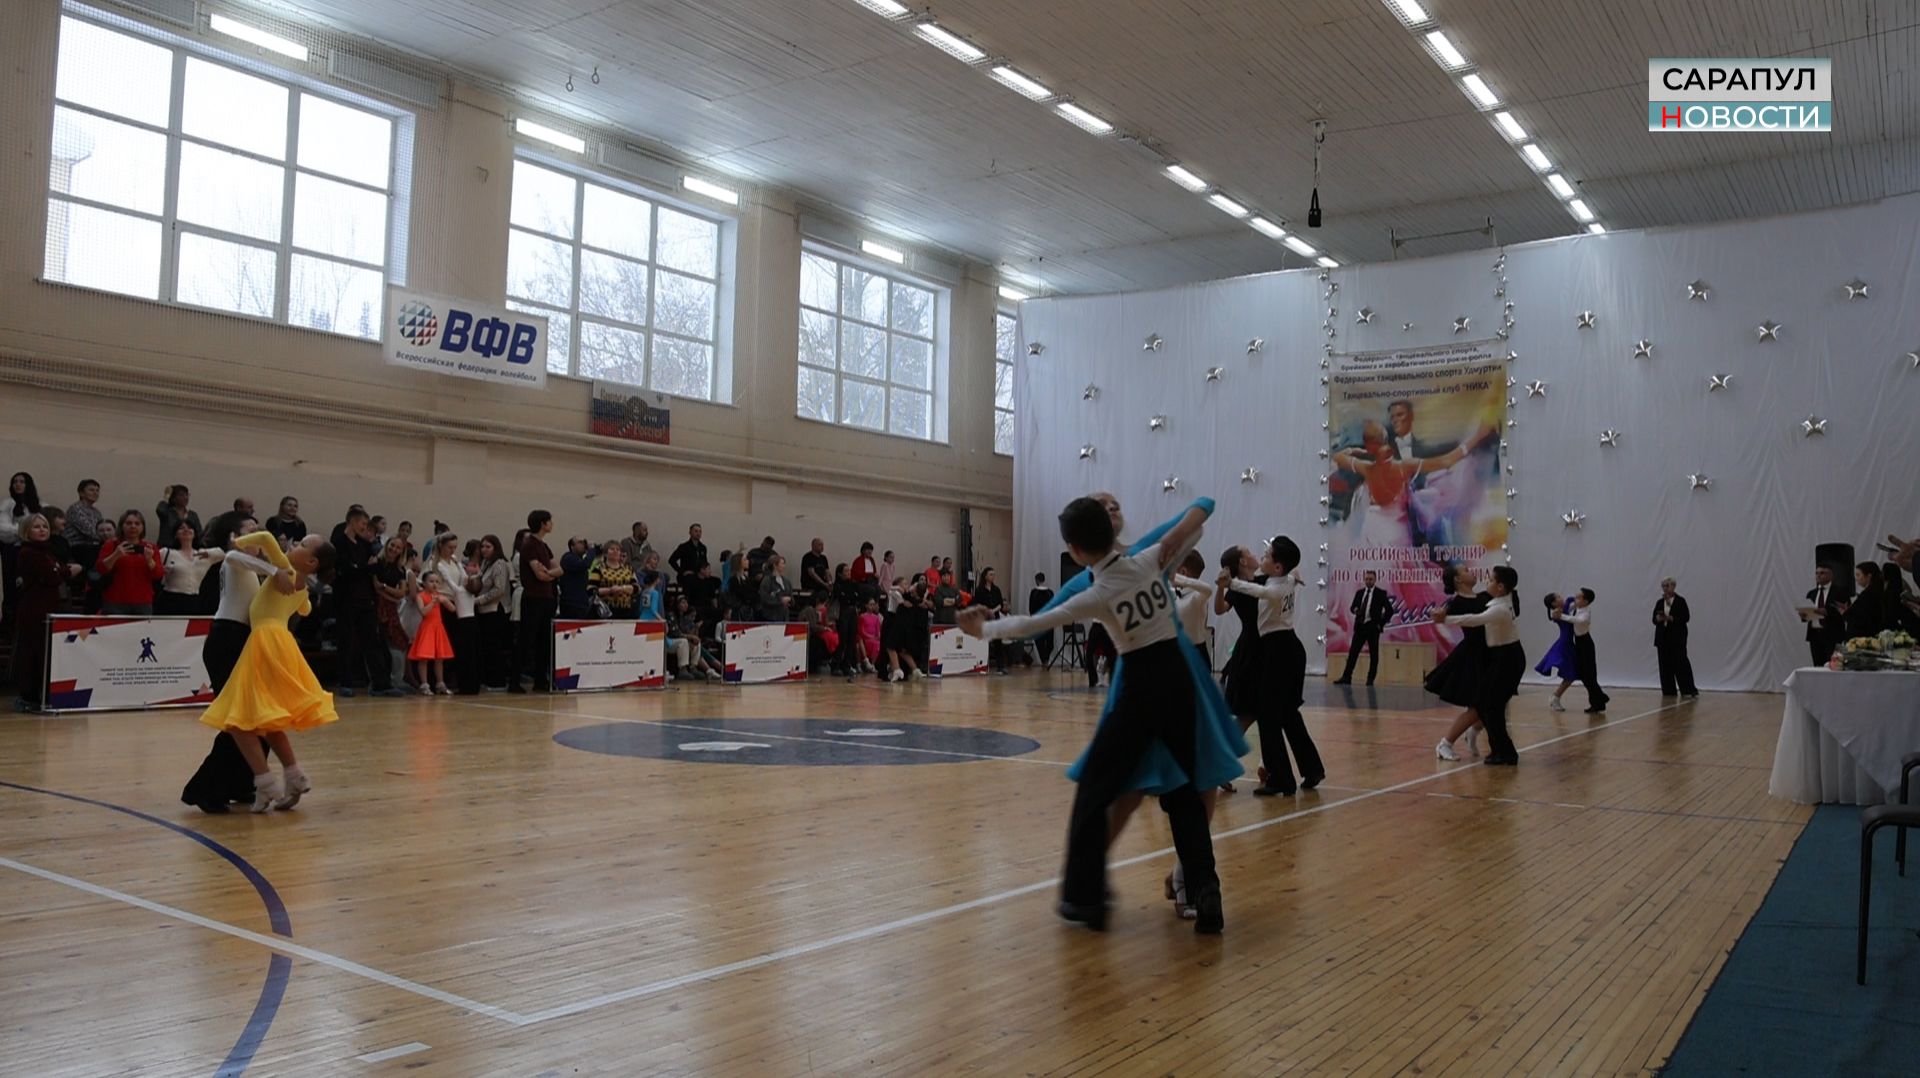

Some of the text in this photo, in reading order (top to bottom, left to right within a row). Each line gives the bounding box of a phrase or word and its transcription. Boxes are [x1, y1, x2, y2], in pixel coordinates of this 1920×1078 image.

[440, 309, 537, 365] ВФВ
[396, 351, 455, 369] Всероссийская
[500, 369, 537, 382] волейбола
[1377, 370, 1434, 383] танцевального
[1435, 369, 1463, 379] спорта
[1464, 364, 1502, 375] Удмуртии
[1343, 380, 1493, 401] Танцевально-спортивный клуб "НИКА"
[1350, 544, 1487, 561] РОССИЙСКИЙ ТУРНИР
[1116, 580, 1168, 633] 209
